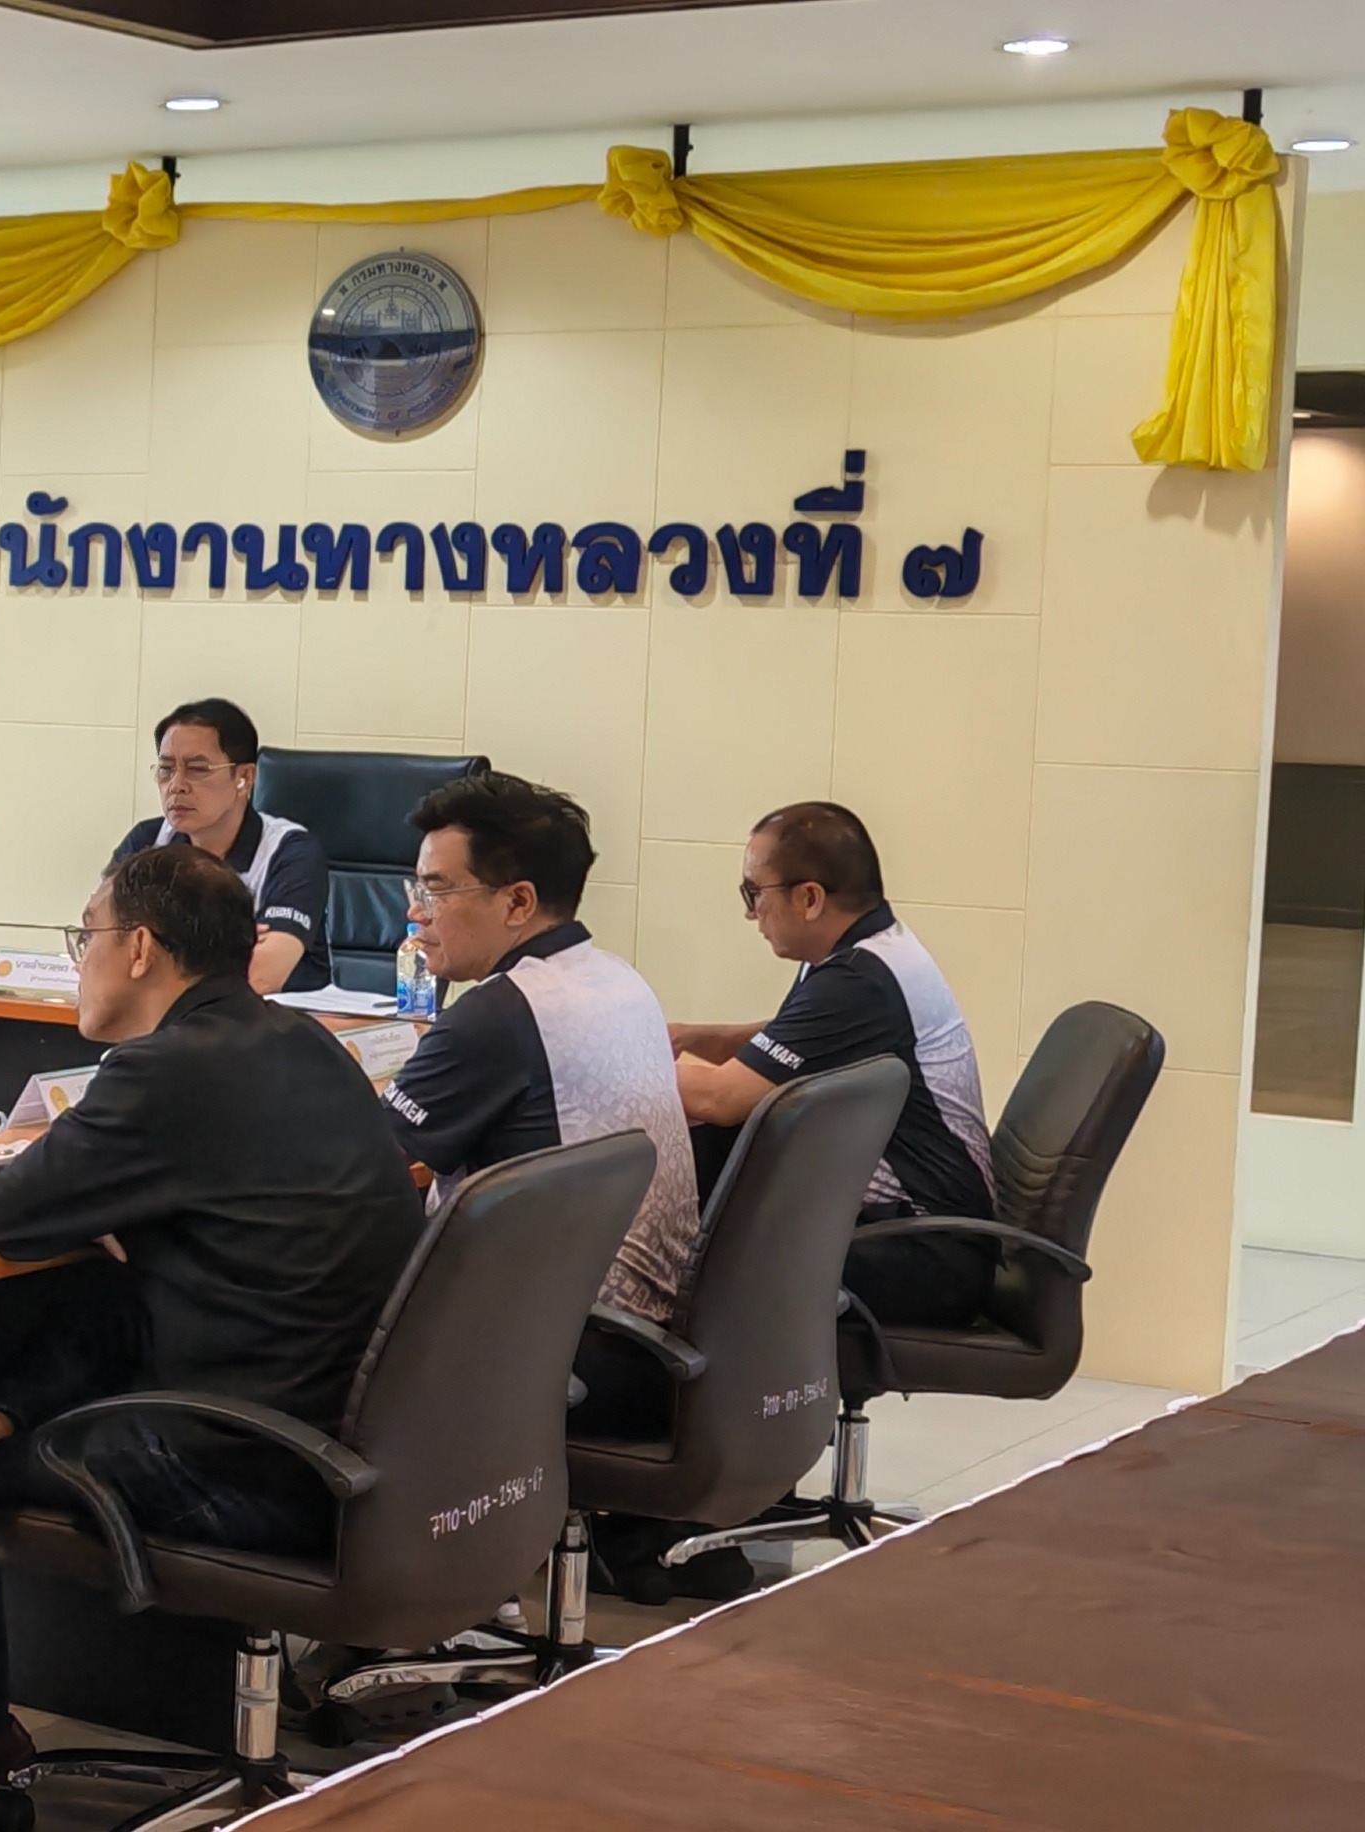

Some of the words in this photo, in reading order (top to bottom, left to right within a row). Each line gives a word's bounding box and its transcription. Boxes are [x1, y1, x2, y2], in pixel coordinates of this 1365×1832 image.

[351, 261, 437, 287] กรมทางหลวง
[901, 526, 985, 600] ๗
